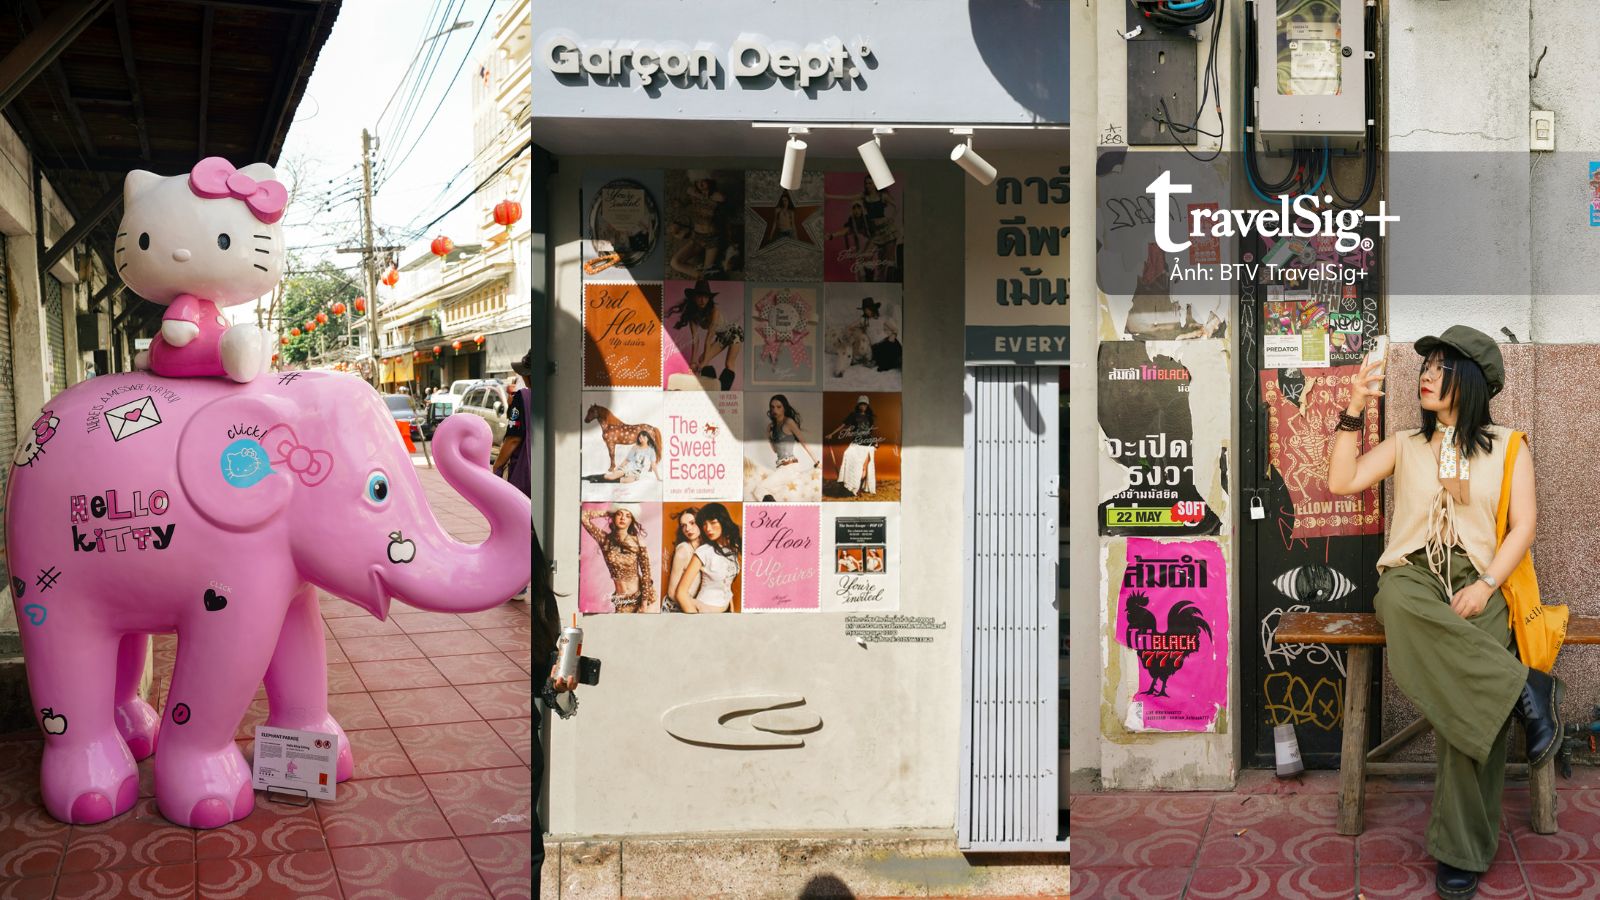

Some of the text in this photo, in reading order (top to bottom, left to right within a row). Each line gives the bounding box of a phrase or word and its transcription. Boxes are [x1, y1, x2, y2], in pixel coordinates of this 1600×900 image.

[548, 36, 717, 85] Garçon
[590, 289, 629, 310] 3rd
[595, 308, 655, 343] floor
[995, 336, 1066, 352] EVERY
[1157, 368, 1189, 380] BLACK
[669, 416, 698, 434] The
[669, 436, 716, 457] Sweet
[669, 458, 726, 485] Escape
[1116, 512, 1162, 523] 22 MAY
[1177, 501, 1206, 516] SOFT
[750, 510, 787, 529] 3rd
[750, 526, 811, 556] floor
[1152, 634, 1198, 650] BLACK
[1141, 651, 1185, 668] 777
